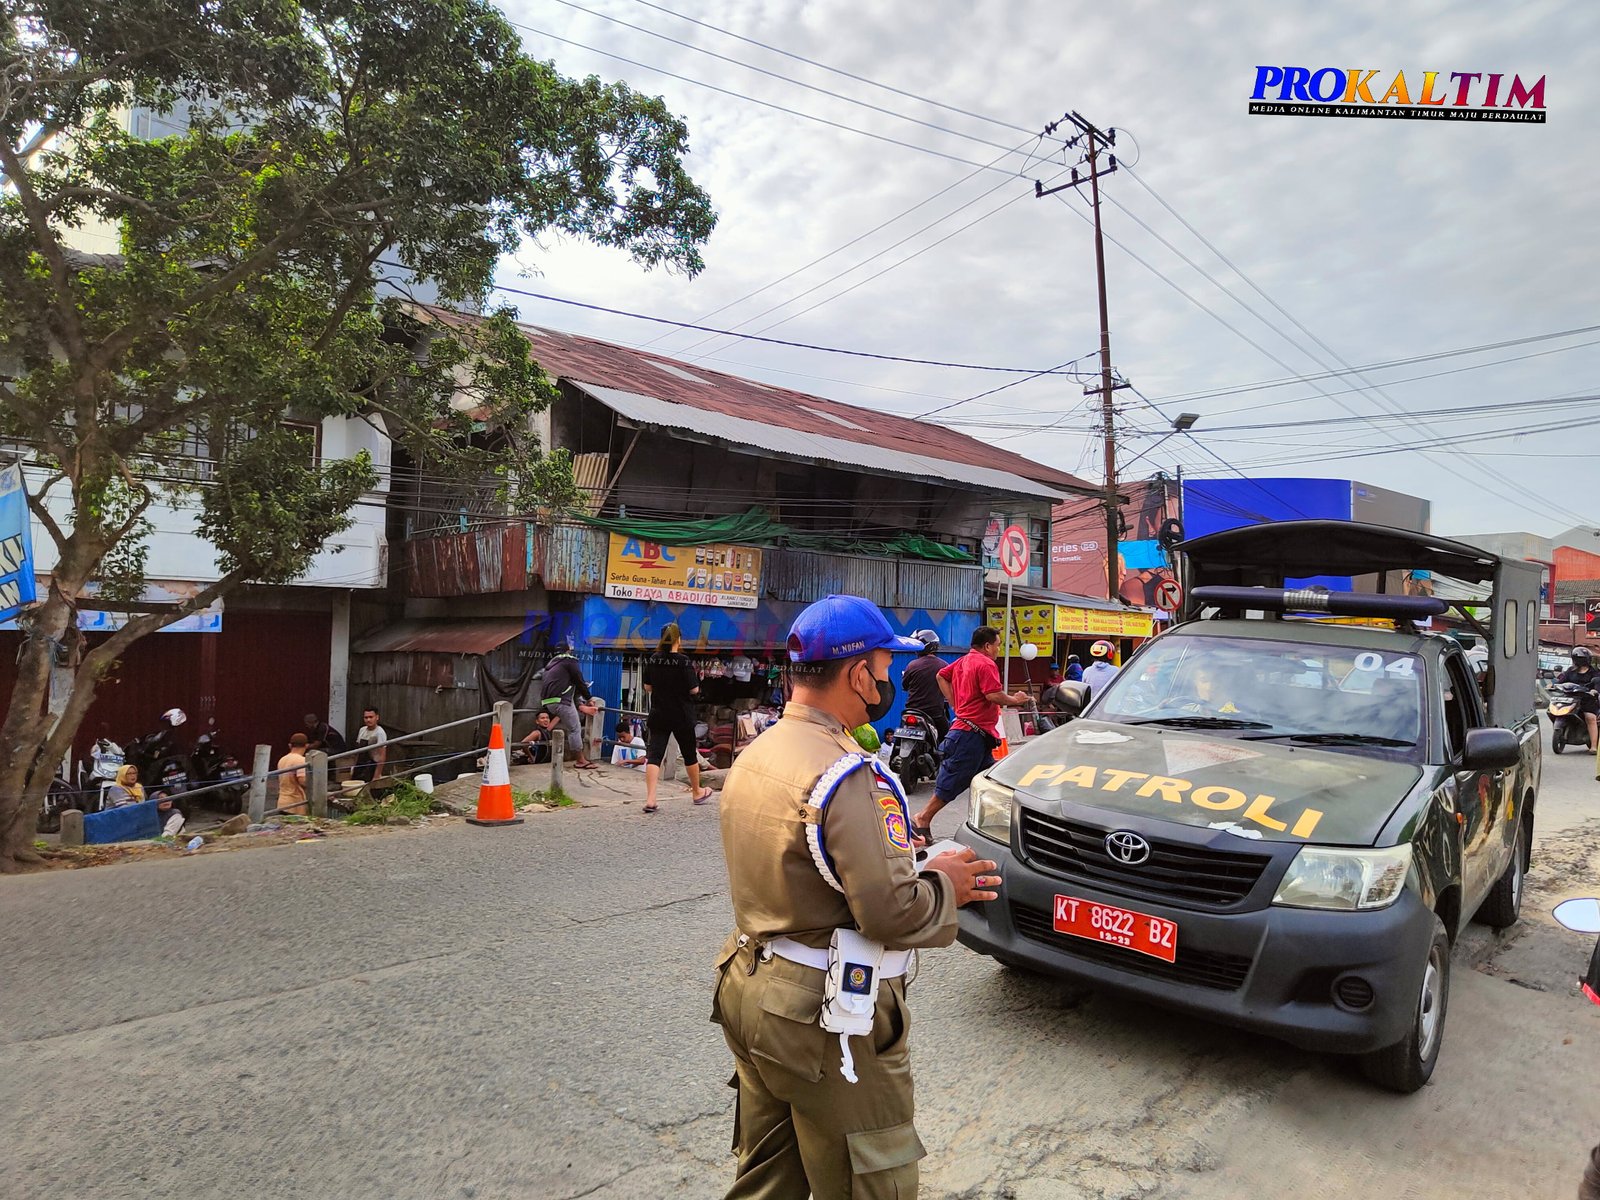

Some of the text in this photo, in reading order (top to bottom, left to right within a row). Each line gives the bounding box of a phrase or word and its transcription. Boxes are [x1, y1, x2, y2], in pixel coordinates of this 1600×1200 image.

[621, 537, 676, 562] ABC
[610, 572, 630, 582] Serba
[668, 578, 685, 587] Lama
[611, 585, 633, 598] Toko
[635, 588, 663, 600] RAYA
[1354, 652, 1415, 677] 04
[1016, 764, 1324, 839] PATROLI
[1056, 897, 1174, 948] KT 8622 BZ
